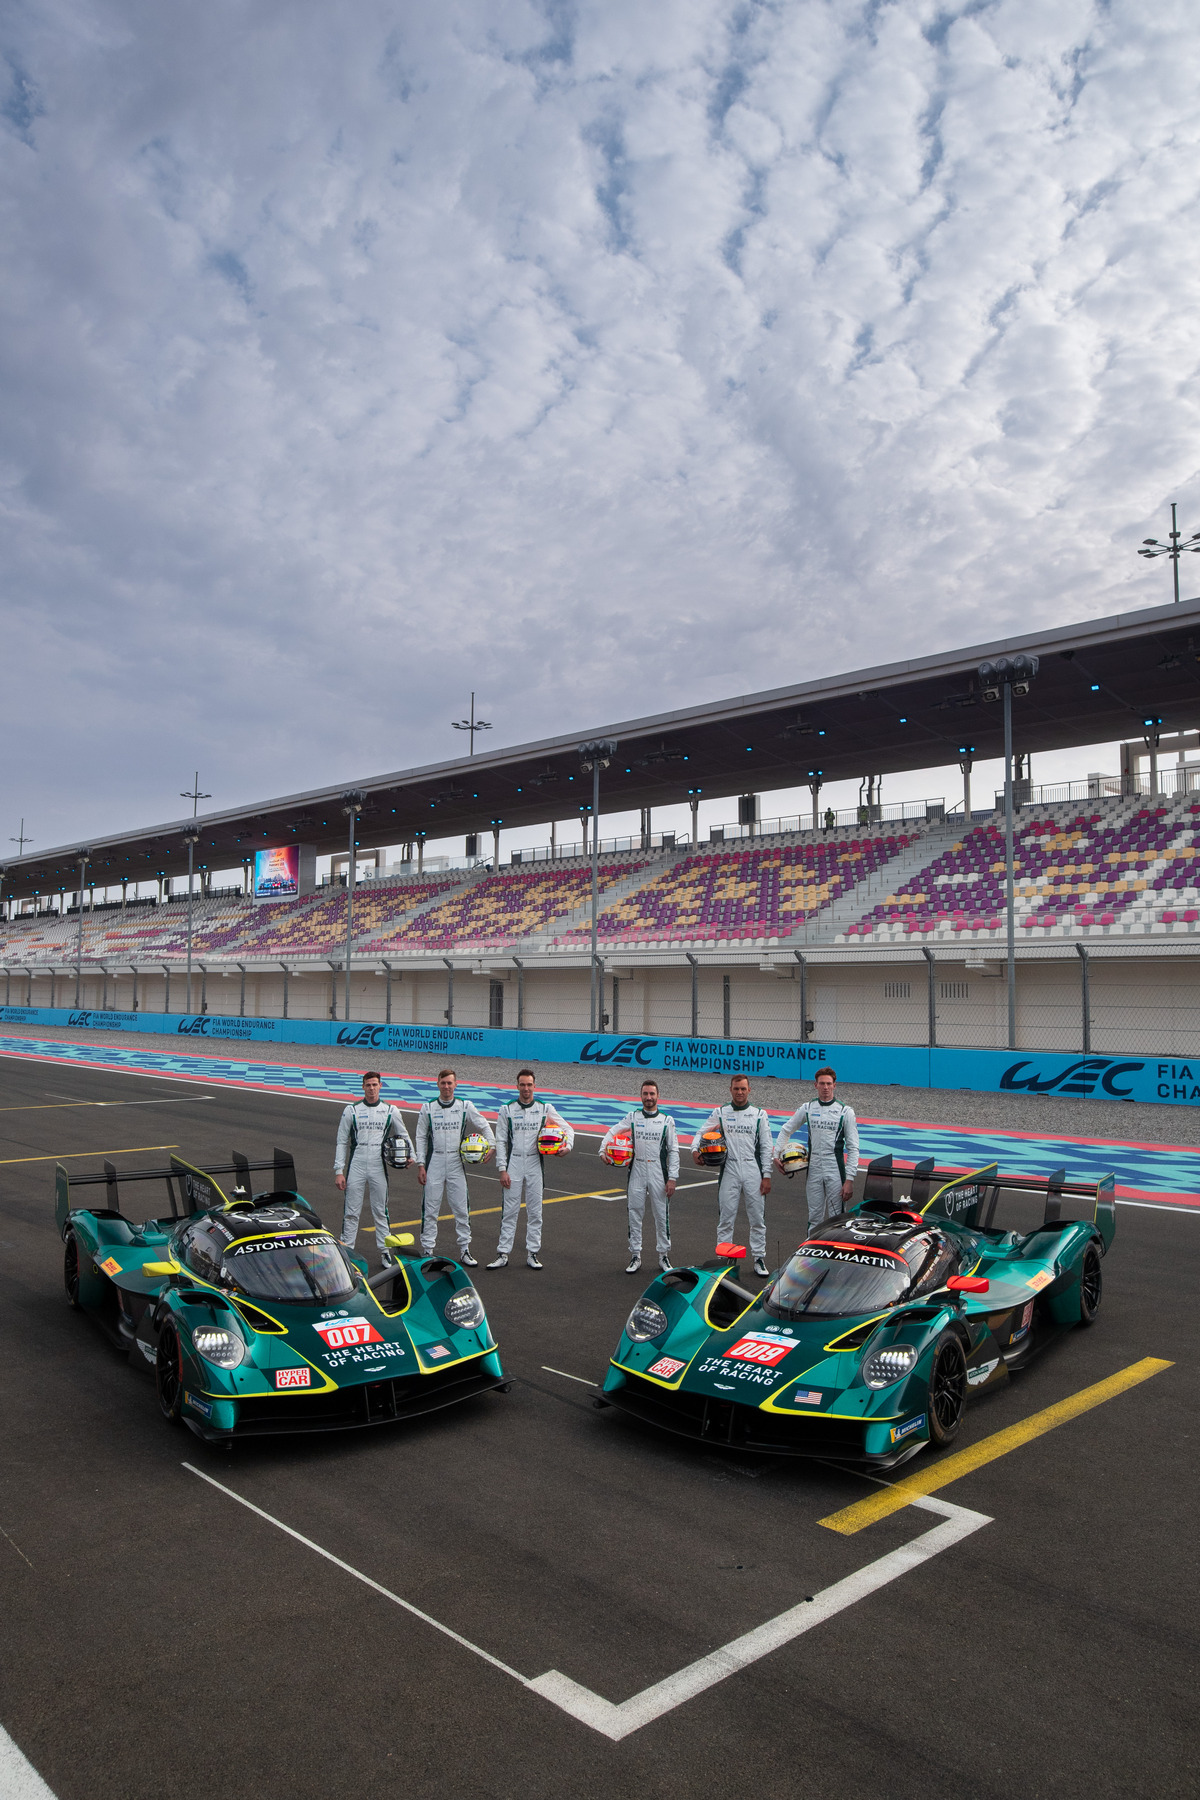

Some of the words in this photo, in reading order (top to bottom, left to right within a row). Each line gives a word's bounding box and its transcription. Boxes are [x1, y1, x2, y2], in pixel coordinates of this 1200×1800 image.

[178, 1017, 210, 1034] WEC
[212, 1028, 252, 1036] CHAMPIONSHIP
[242, 1020, 275, 1029] ENDURANCE
[337, 1026, 385, 1046] WEC
[388, 1028, 400, 1036] FIA
[402, 1028, 430, 1038] WORLD
[432, 1030, 484, 1041] ENDURANCE
[388, 1038, 448, 1050] CHAMPIONSHIP
[580, 1038, 658, 1065] WEC
[664, 1042, 684, 1052] FIA
[690, 1042, 734, 1056] WORLD
[739, 1044, 826, 1060] ENDURANCE
[664, 1056, 765, 1072] CHAMPIONSHIP
[1158, 1064, 1193, 1080] FIA
[1000, 1059, 1145, 1096] WEC
[234, 1240, 285, 1256] ASTON
[289, 1236, 337, 1246] MARTIN
[835, 1252, 896, 1270] MARTIN
[326, 1324, 370, 1347] 007
[322, 1349, 352, 1360] THE
[355, 1342, 400, 1354] HEART
[329, 1358, 347, 1367] OF
[352, 1349, 405, 1362] RACING
[730, 1342, 785, 1361] 009
[652, 1364, 675, 1376] CAR
[698, 1364, 718, 1372] OF
[720, 1368, 774, 1386] RACING
[705, 1358, 732, 1367] THE
[734, 1362, 783, 1379] HEART
[278, 1376, 308, 1386] CAR
